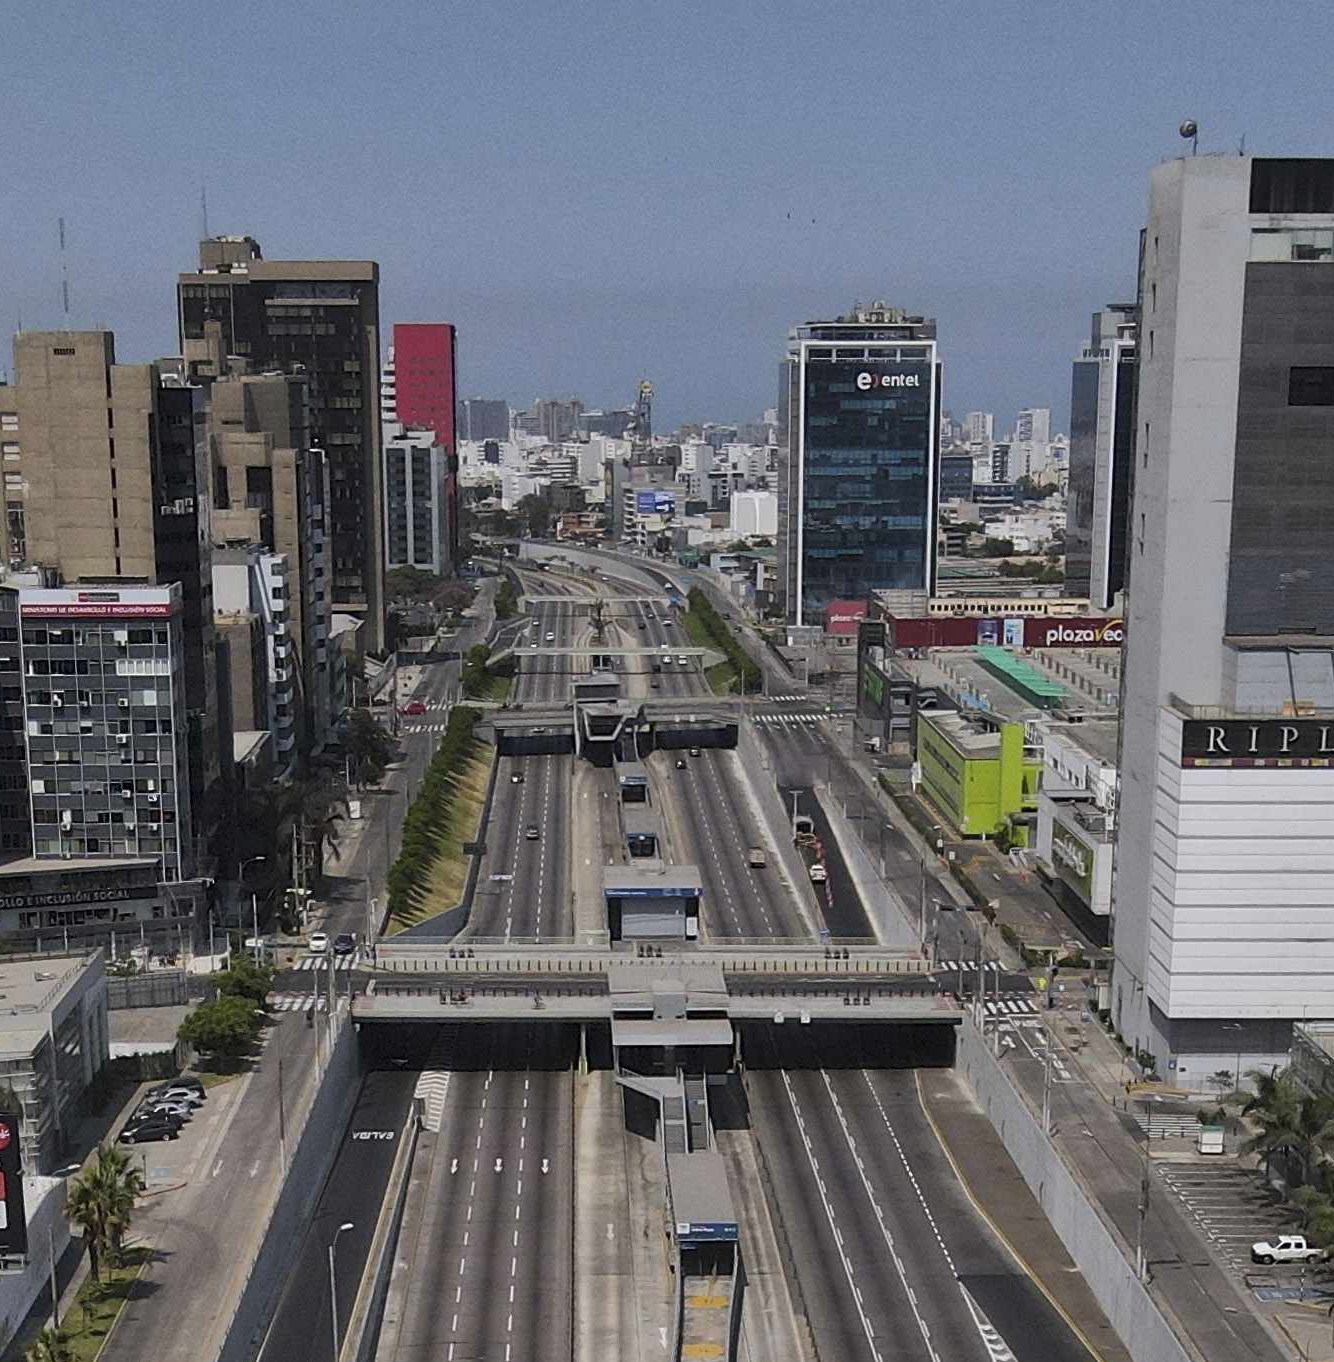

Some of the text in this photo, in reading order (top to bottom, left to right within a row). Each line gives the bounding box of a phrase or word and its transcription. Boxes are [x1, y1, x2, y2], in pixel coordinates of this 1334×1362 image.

[882, 373, 920, 388] entel
[27, 896, 34, 906] E
[35, 891, 91, 906] INCLUSIÓN
[93, 889, 130, 901] SOCIAL
